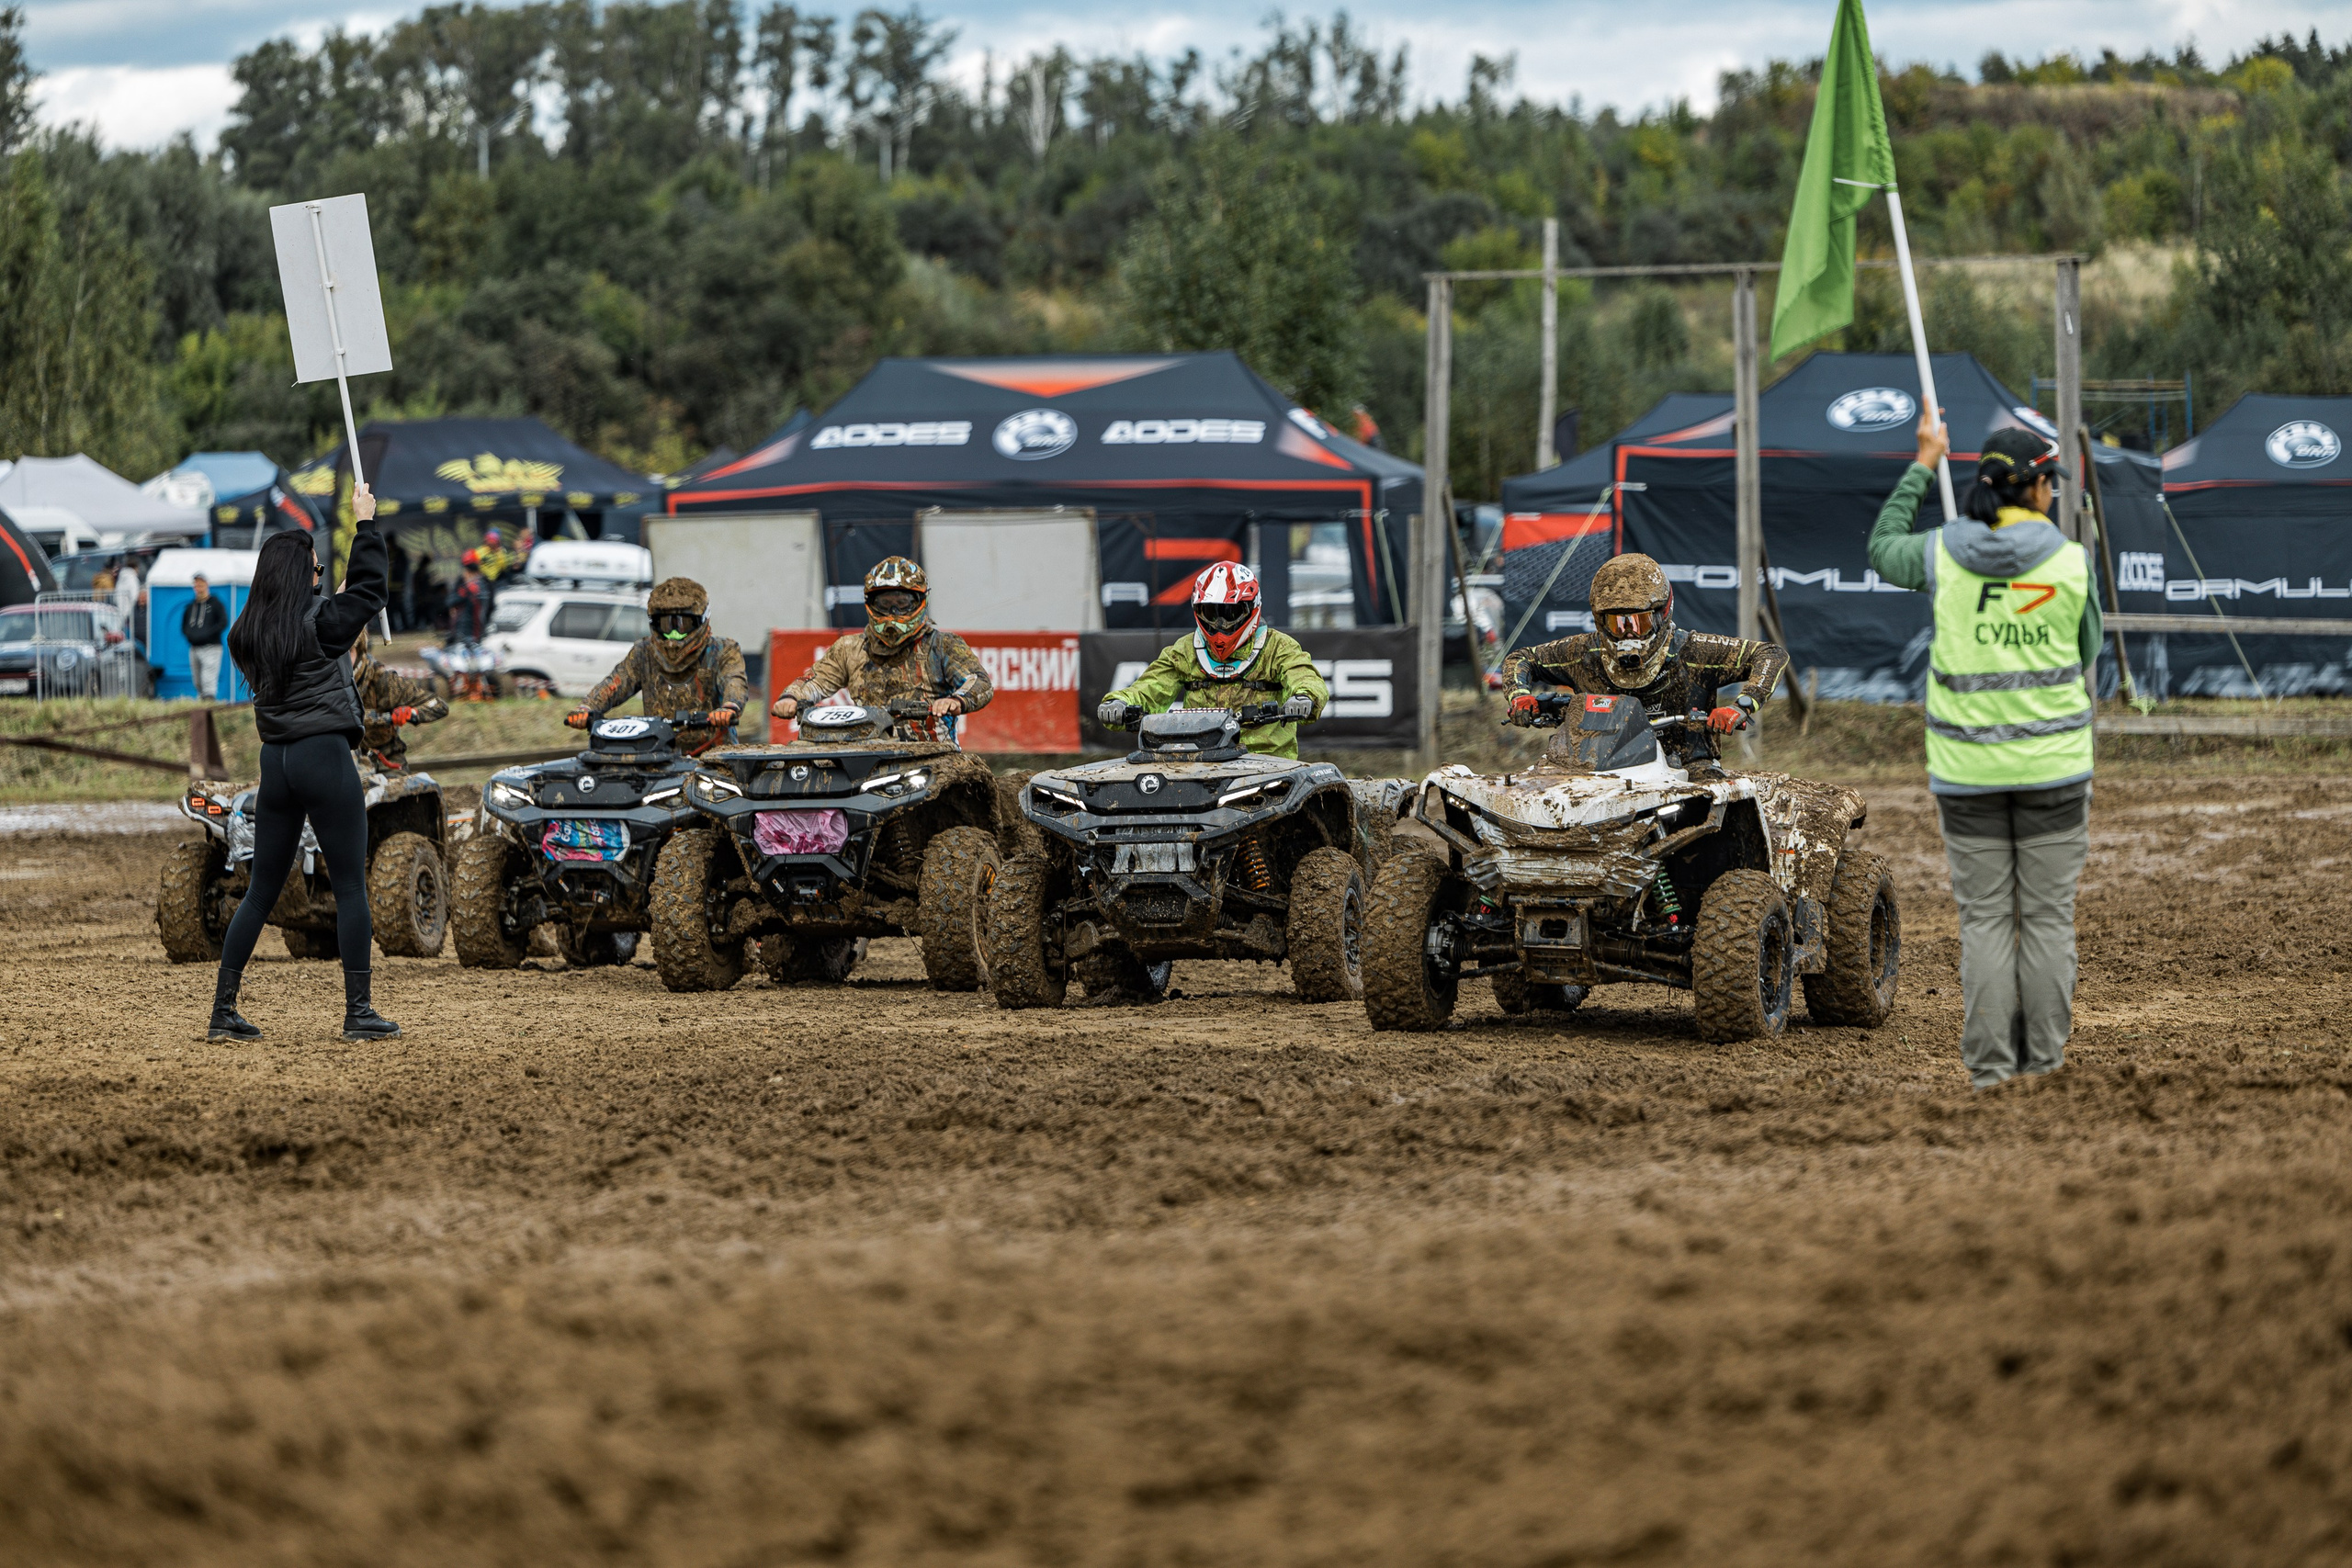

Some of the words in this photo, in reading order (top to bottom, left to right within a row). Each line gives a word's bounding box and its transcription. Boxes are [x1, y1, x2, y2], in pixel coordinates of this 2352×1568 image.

[809, 420, 973, 449] AODES
[1100, 418, 1267, 445] AODES
[1977, 581, 2056, 614] F7
[1975, 623, 2050, 649] СУДЬЯ
[820, 710, 855, 722] 759
